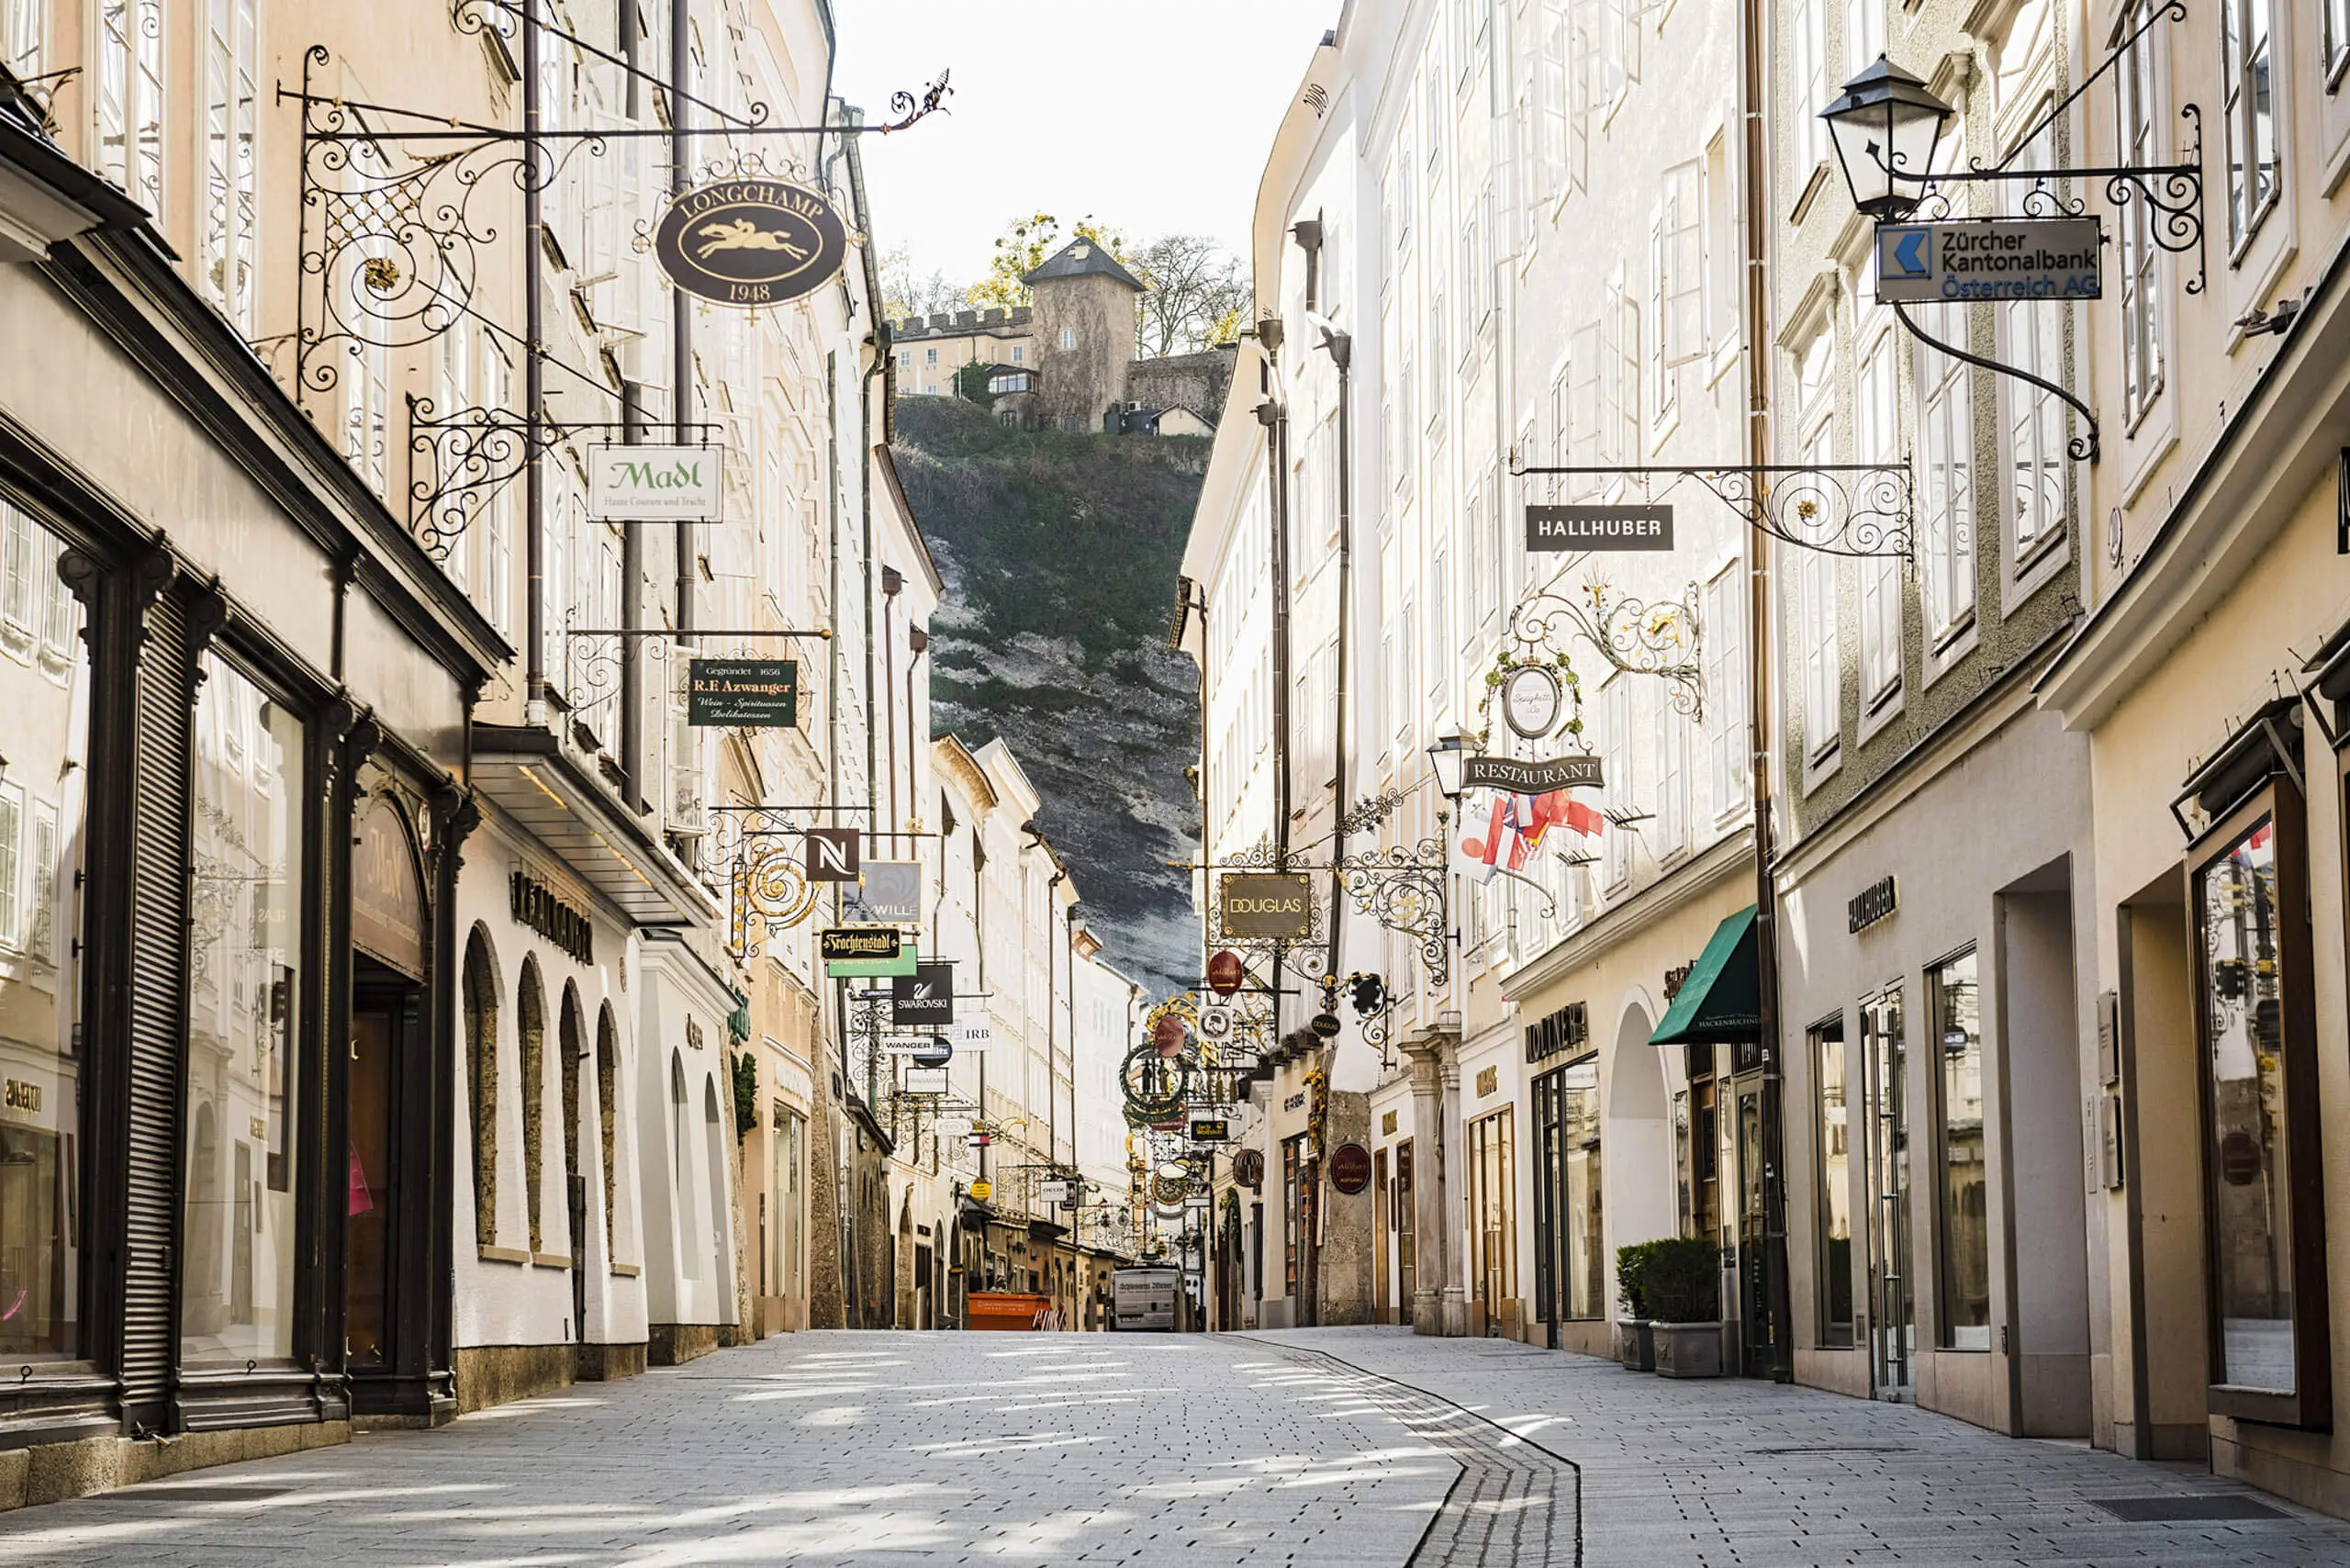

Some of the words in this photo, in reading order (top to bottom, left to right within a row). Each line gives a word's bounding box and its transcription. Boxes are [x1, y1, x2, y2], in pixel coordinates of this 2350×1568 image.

[679, 185, 823, 218] LONGCHAMP
[1942, 230, 2026, 252] Zürcher
[1942, 250, 2097, 273] Kantonalbank
[729, 284, 770, 302] 1948
[1942, 274, 2056, 298] Österreich
[2064, 274, 2098, 295] AG
[608, 460, 702, 489] Madl
[604, 497, 628, 506] Haute
[630, 497, 662, 506] Couture
[664, 497, 679, 506] und
[681, 497, 706, 506] Tracht
[1539, 520, 1662, 536] HALLHUBER
[706, 666, 752, 677] Gegründet
[760, 667, 781, 677] 1656
[722, 679, 791, 696] Azwanger
[697, 697, 723, 707] Wein
[734, 698, 787, 709] Spirituosen
[710, 709, 772, 719] Delikatessen
[1474, 763, 1595, 785] RESTAURANT
[1230, 899, 1302, 913] DOUGLAS
[1848, 875, 1897, 935] HALLHUBER
[898, 999, 947, 1009] SWAROVSKI
[966, 1029, 990, 1039] IRB
